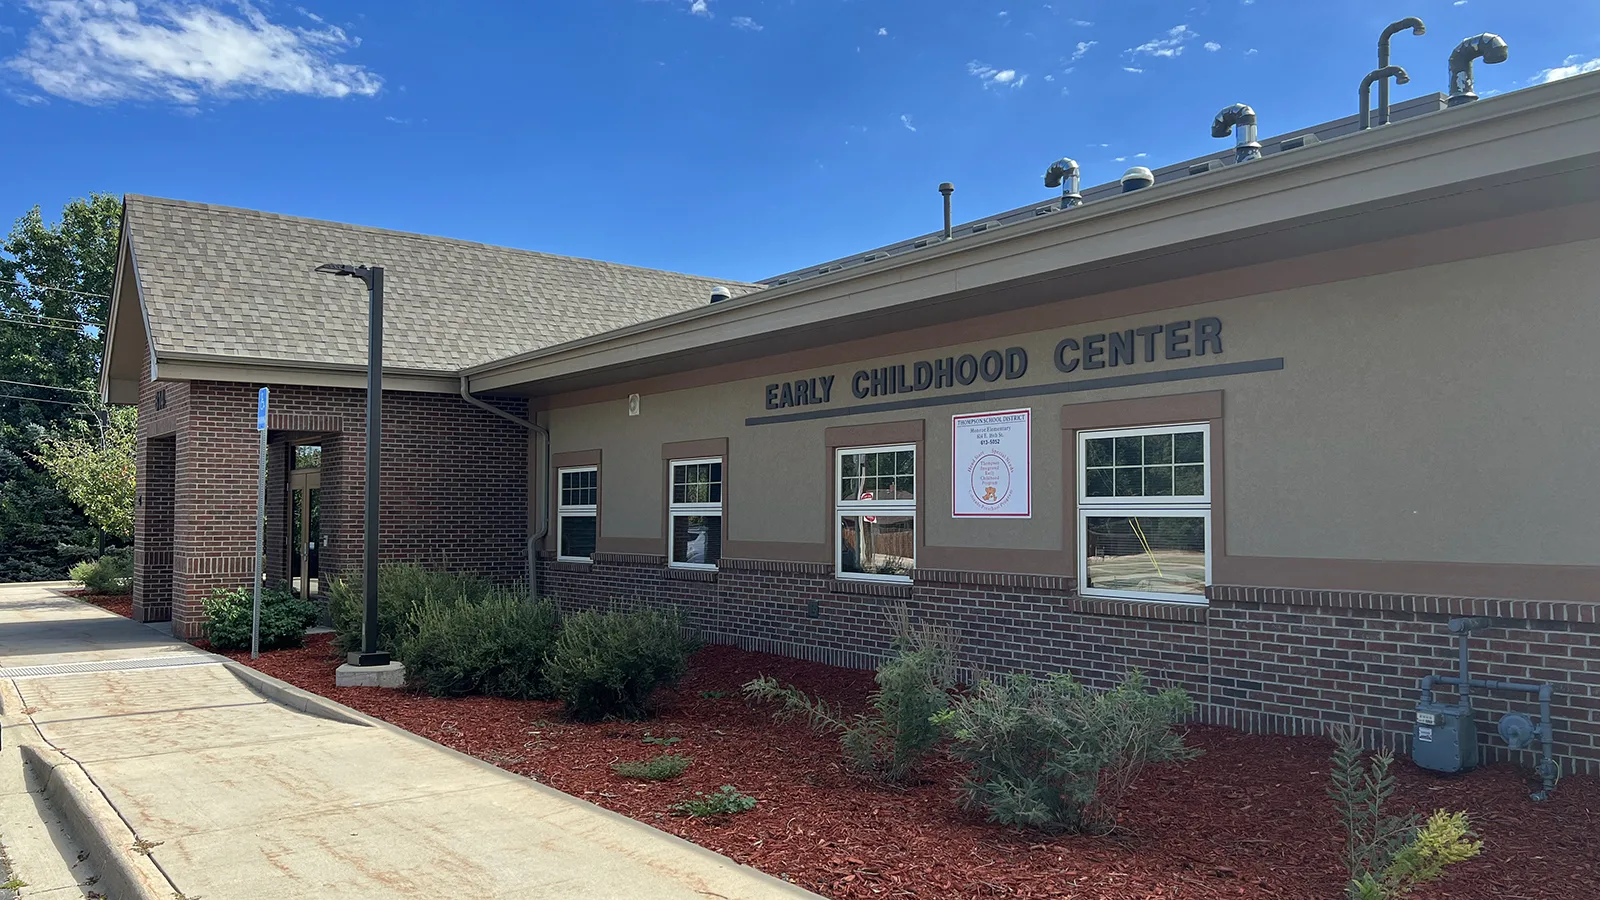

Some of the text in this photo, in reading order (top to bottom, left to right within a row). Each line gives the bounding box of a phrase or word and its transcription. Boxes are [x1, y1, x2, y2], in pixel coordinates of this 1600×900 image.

[765, 317, 1223, 410] EARLY CHILDHOOD CENTER
[1003, 414, 1025, 422] DISTRICT
